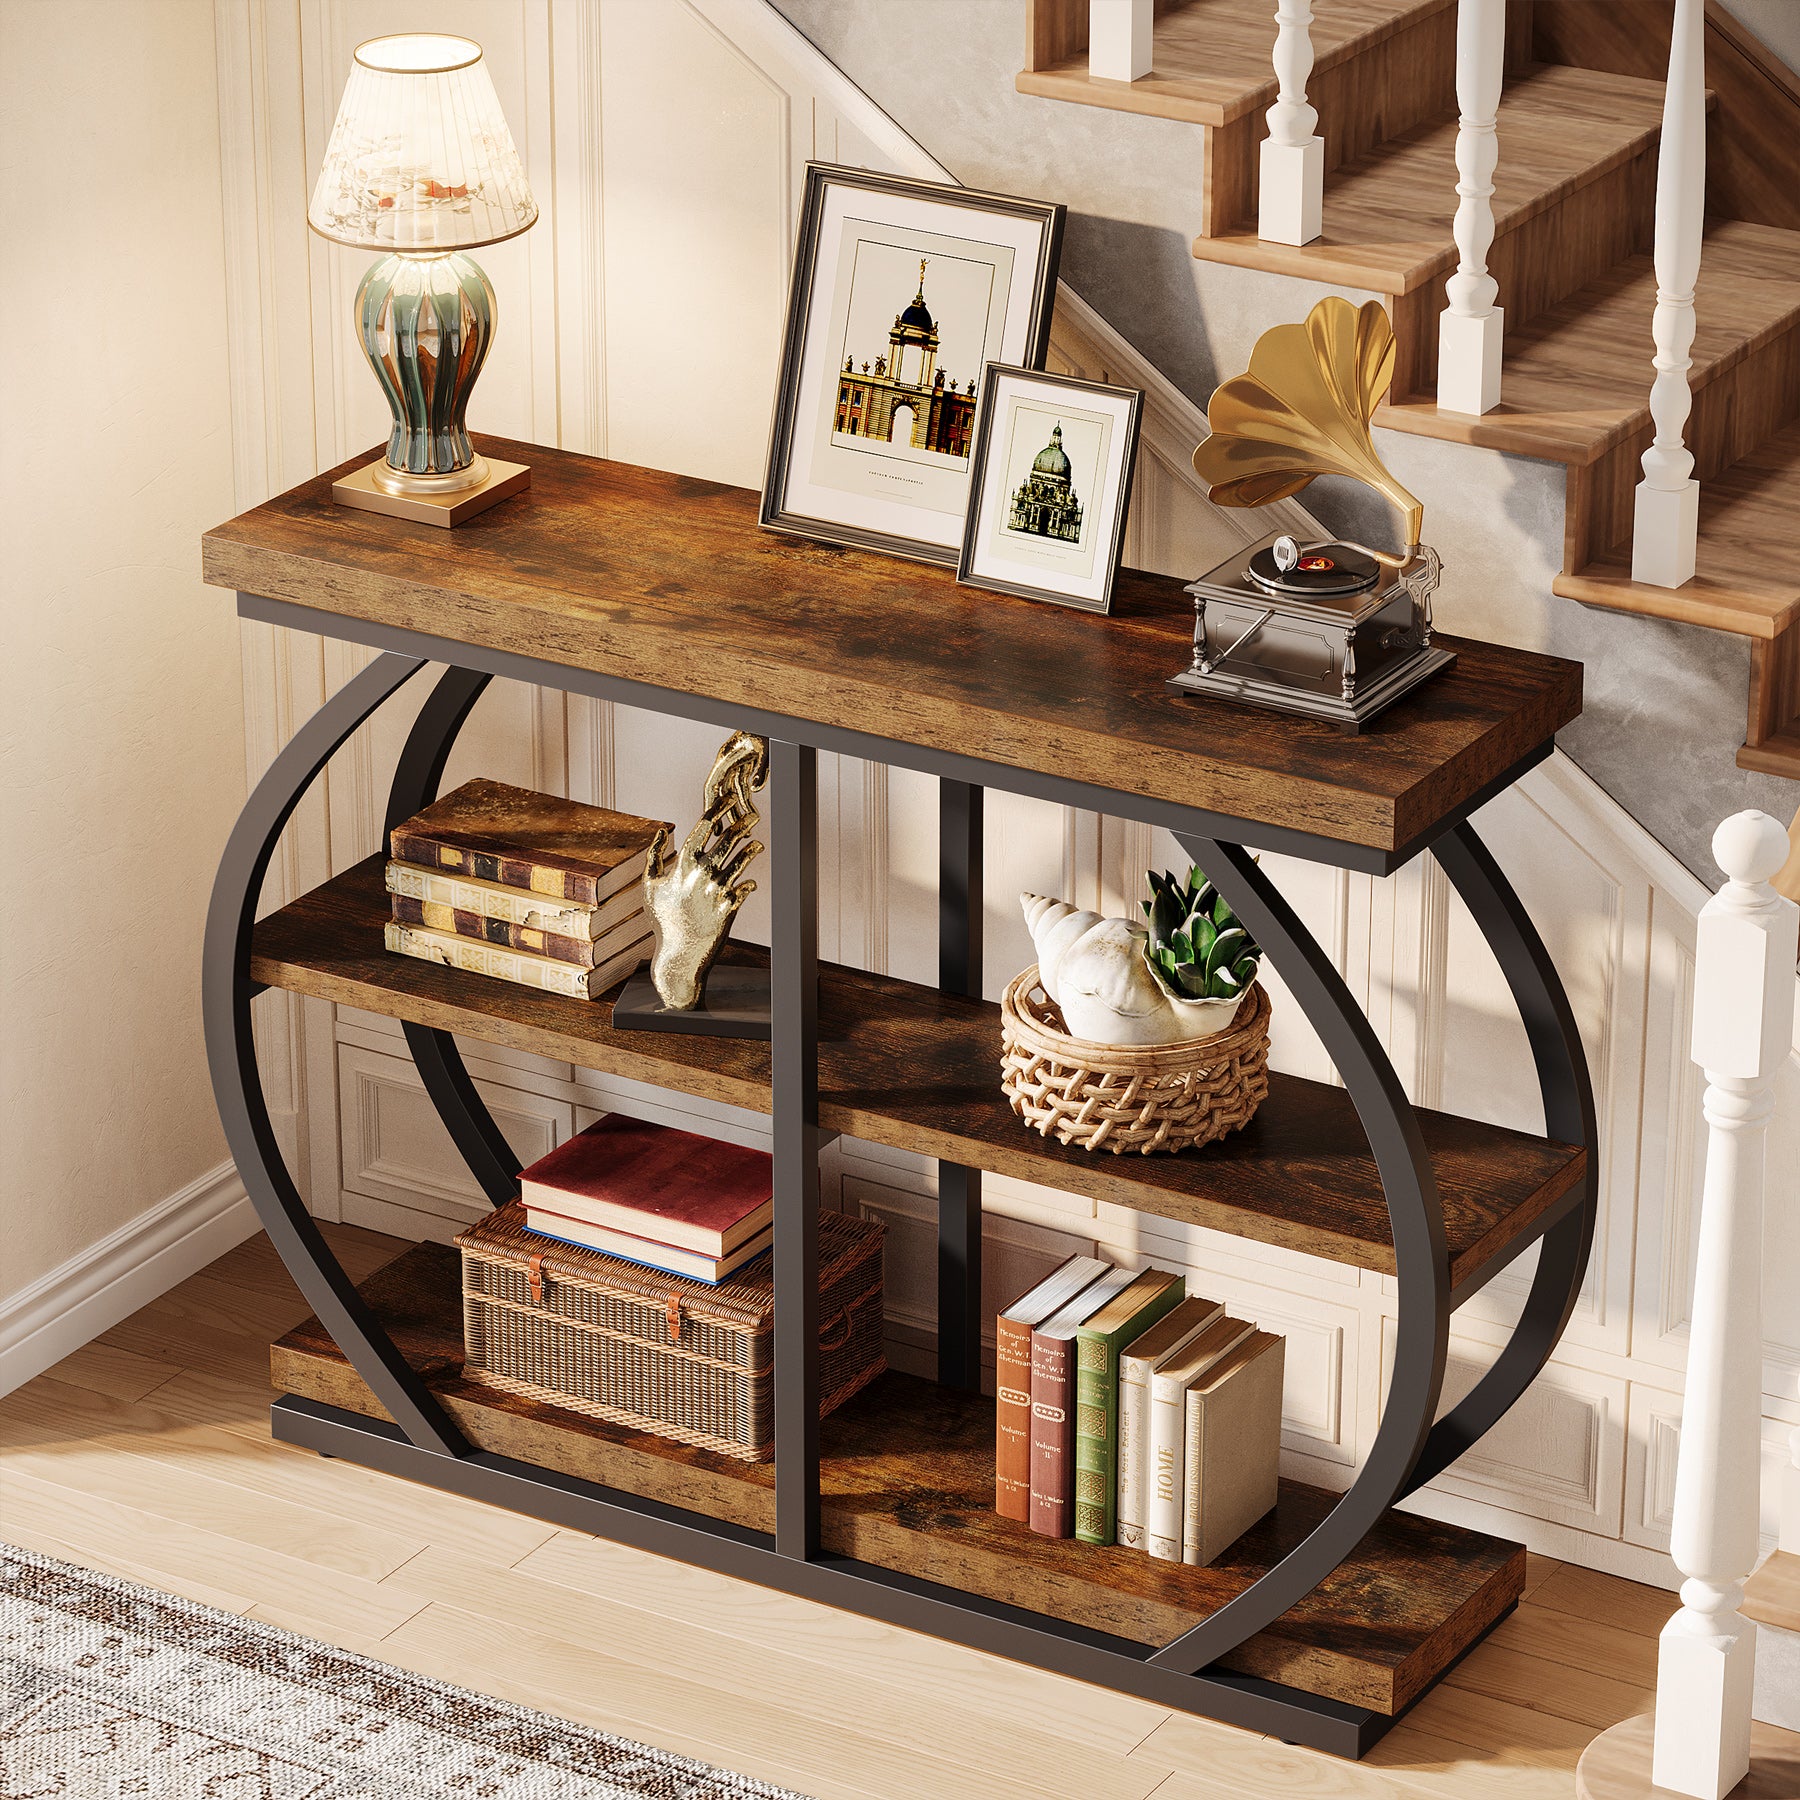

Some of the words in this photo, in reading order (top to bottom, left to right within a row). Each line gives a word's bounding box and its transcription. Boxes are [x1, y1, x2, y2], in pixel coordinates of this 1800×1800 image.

[1000, 1328, 1031, 1342] Memoirs
[1034, 1344, 1065, 1358] Memoirs
[998, 1354, 1031, 1367] Sherman
[1033, 1369, 1066, 1383] Sherman
[1191, 1403, 1200, 1427] WITH
[1001, 1424, 1027, 1437] Volume
[1190, 1428, 1200, 1446] THE
[1035, 1441, 1061, 1453] Volume
[1190, 1447, 1199, 1480] THINGS
[1157, 1445, 1174, 1502] HOME
[1189, 1481, 1199, 1496] WE
[1189, 1496, 1199, 1520] LOVE
